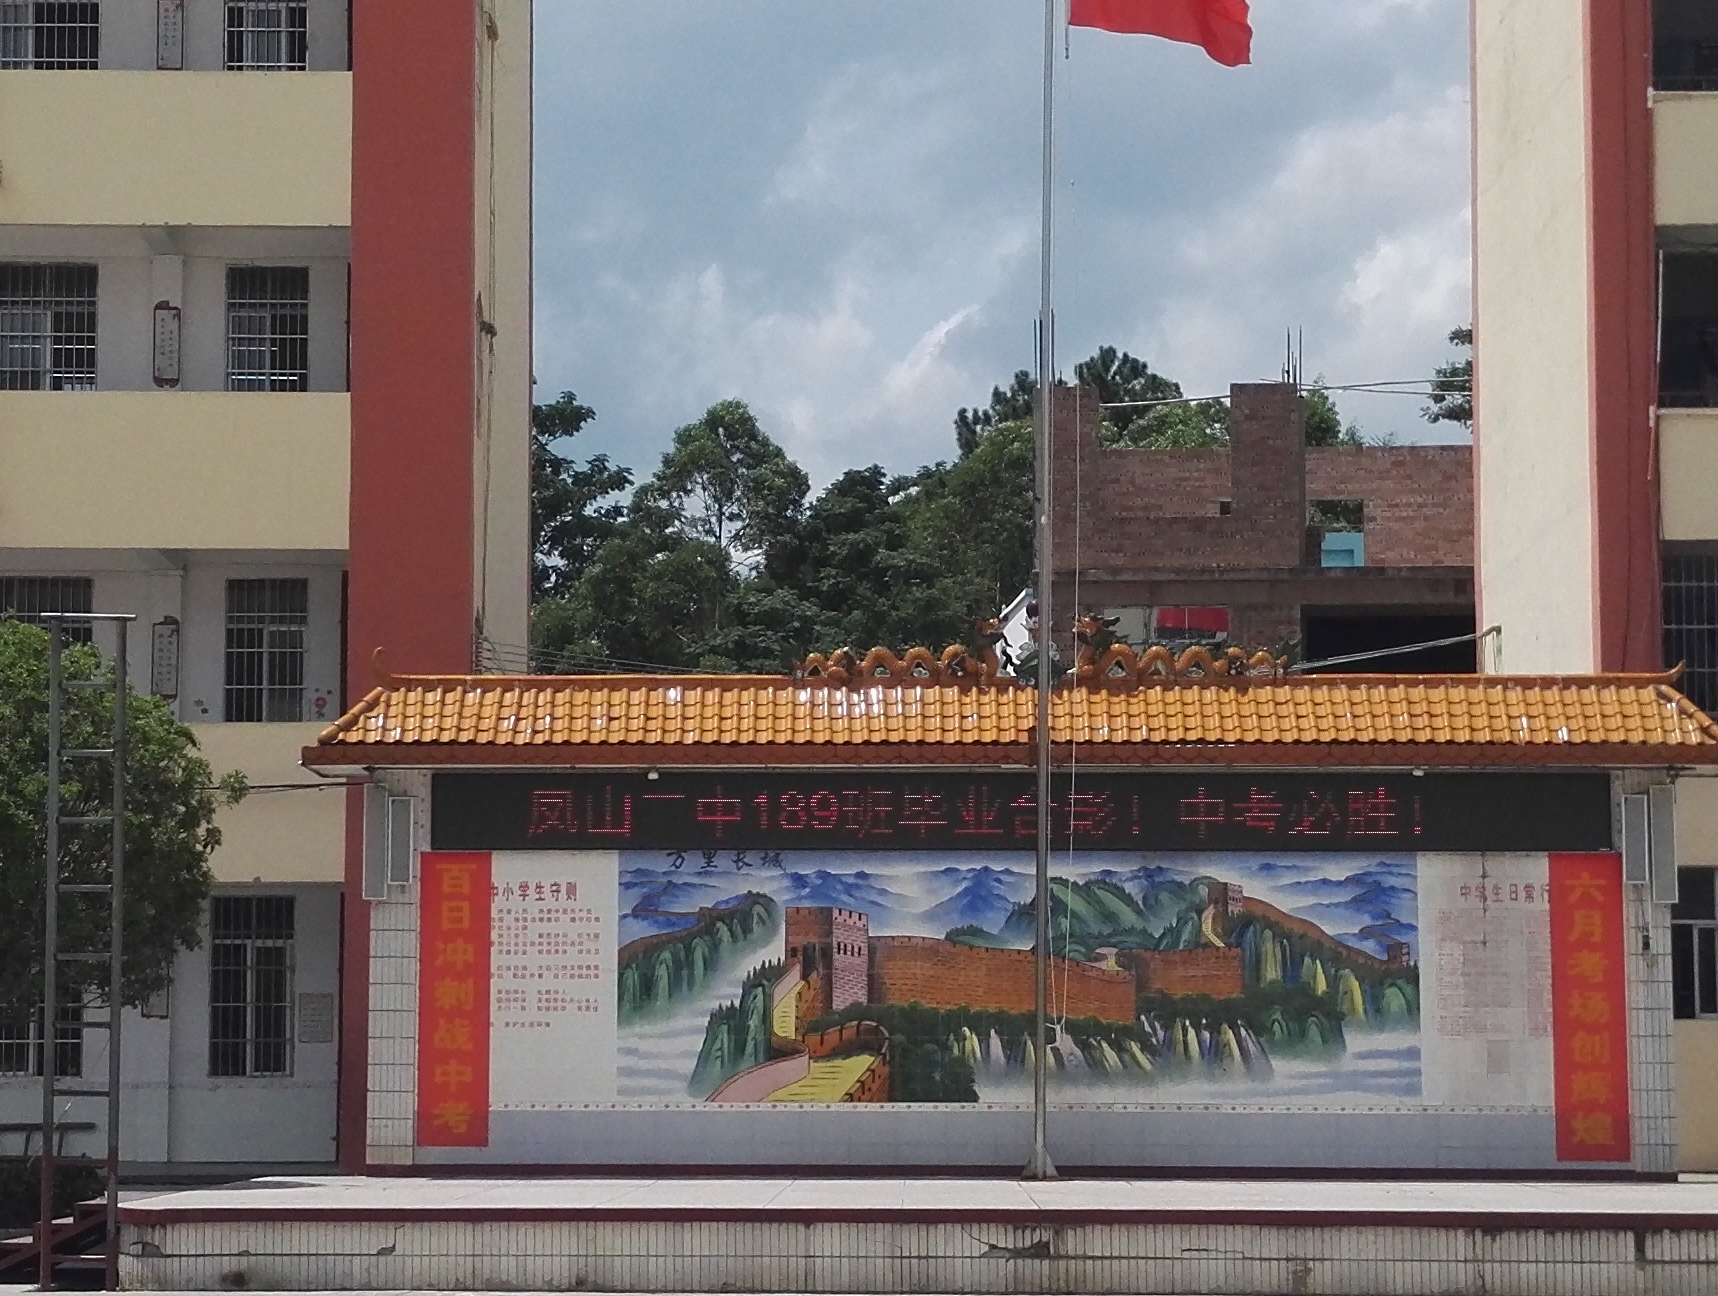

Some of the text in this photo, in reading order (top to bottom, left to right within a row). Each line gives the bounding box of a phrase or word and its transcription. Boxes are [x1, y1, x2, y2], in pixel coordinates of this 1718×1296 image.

[666, 850, 786, 872] 万里长城
[433, 863, 477, 1134] 百日冲刺战中考
[1563, 872, 1617, 1146] 六月考场创辉煌
